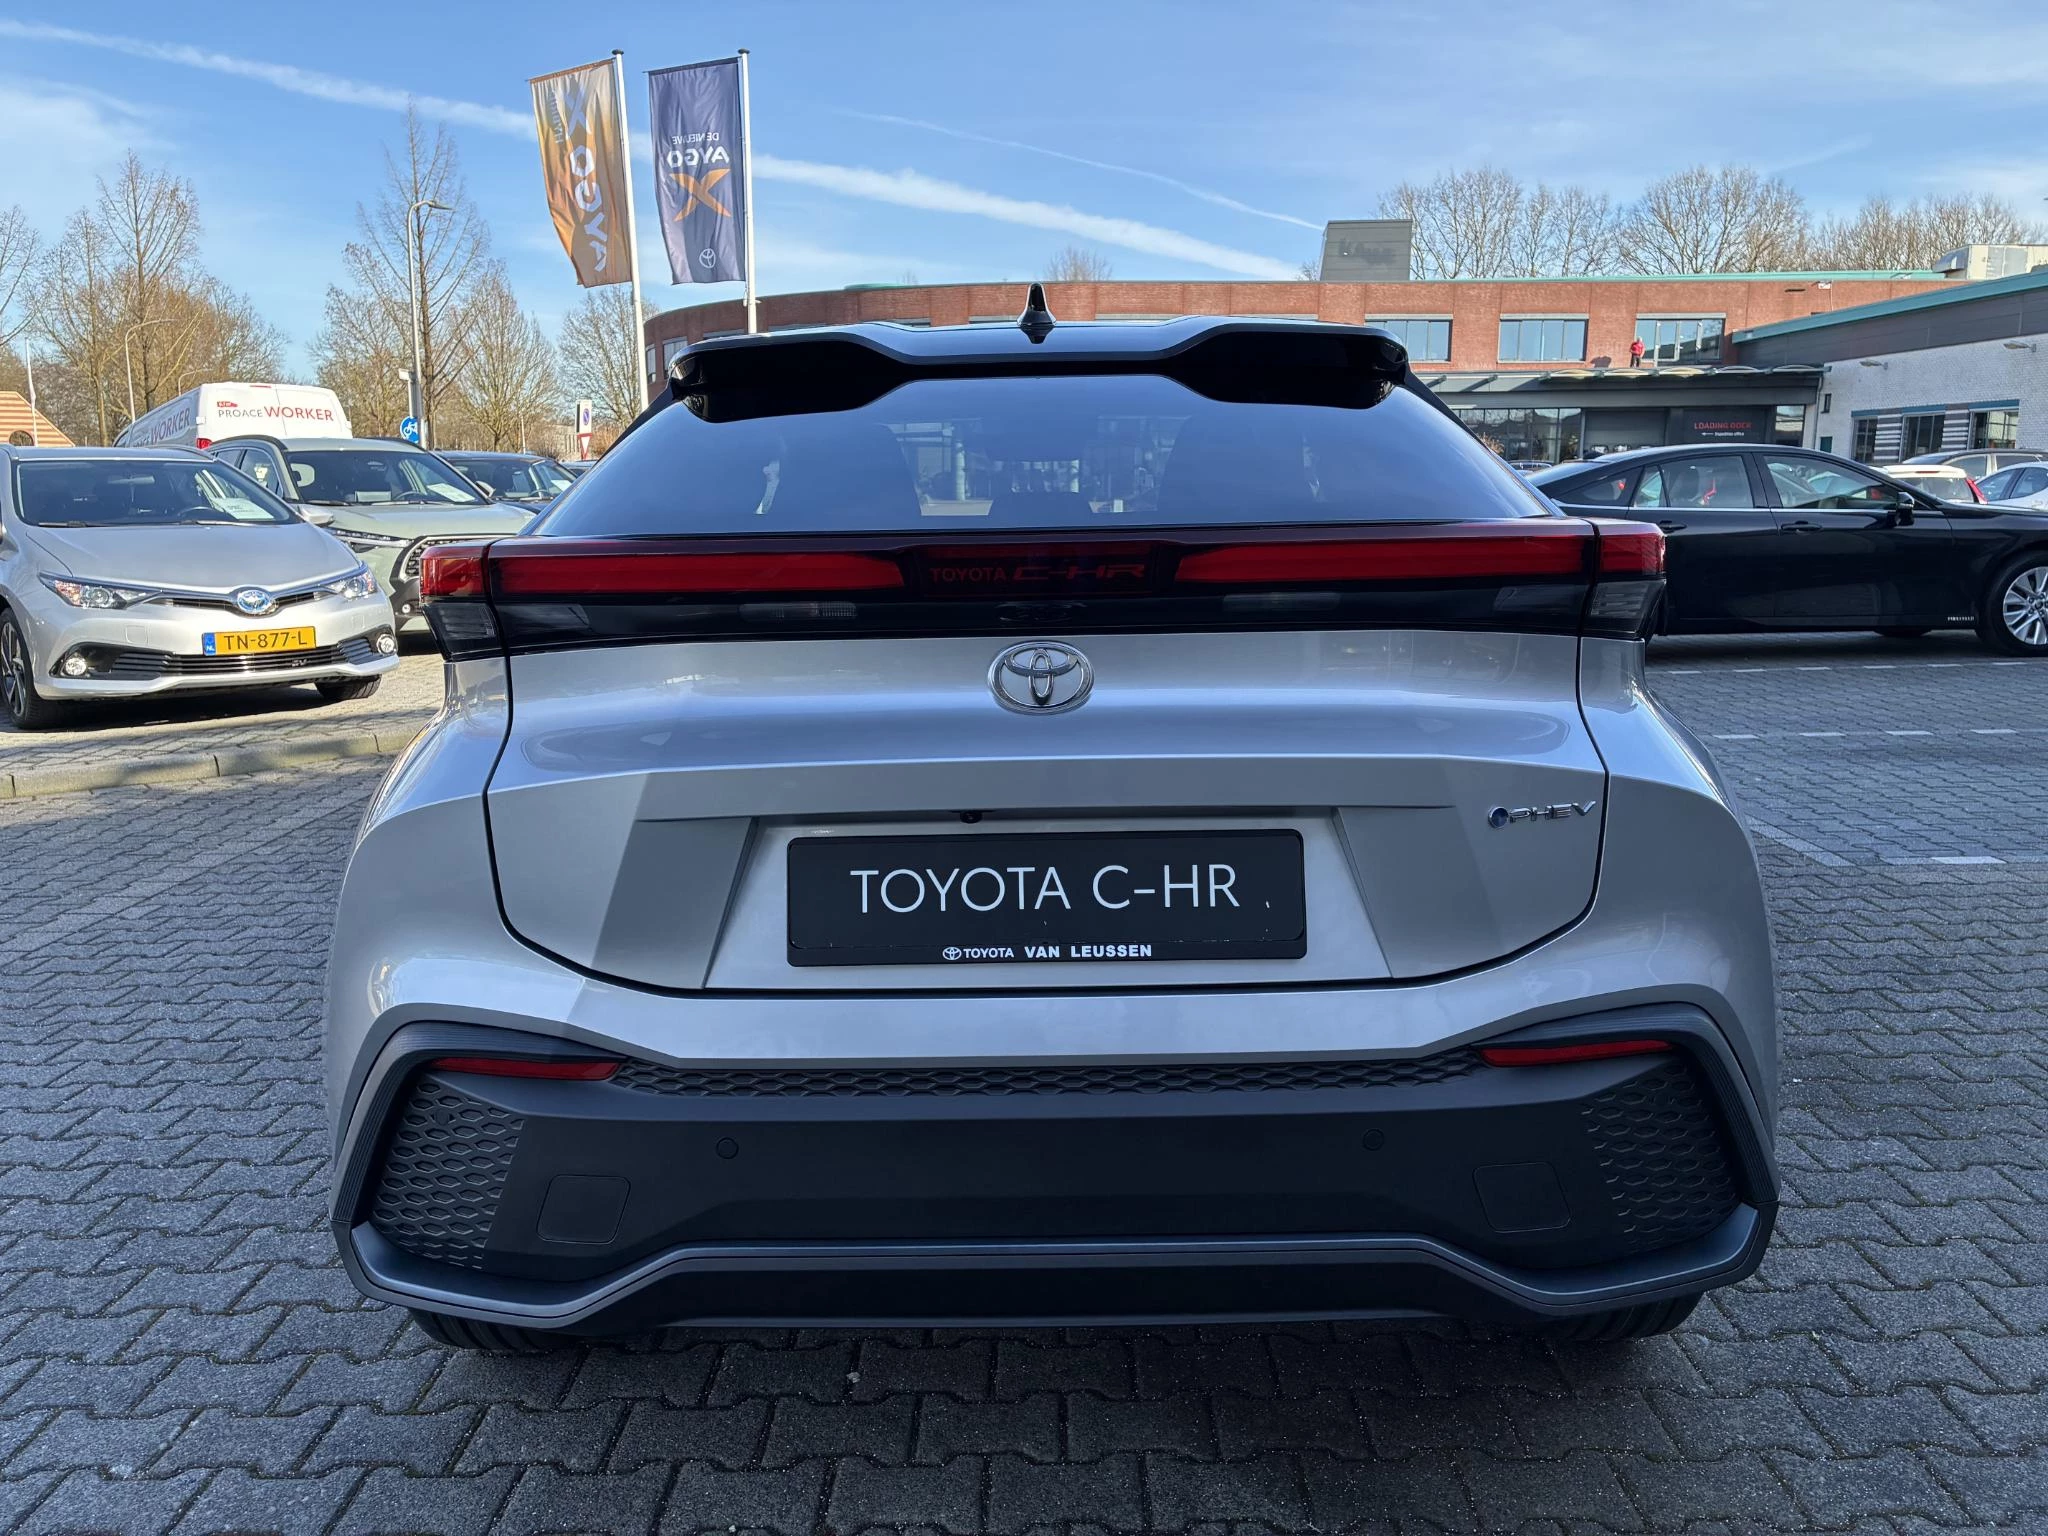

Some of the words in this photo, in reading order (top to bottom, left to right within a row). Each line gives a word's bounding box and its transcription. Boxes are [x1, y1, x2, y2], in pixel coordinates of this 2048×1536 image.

[218, 409, 263, 418] PROACE
[264, 406, 334, 421] WORKER
[151, 407, 190, 445] WORKER
[1694, 421, 1729, 430] LOADING
[929, 567, 1007, 583] TOYOTA
[1013, 564, 1145, 581] C-HR
[206, 644, 215, 652] NL
[224, 630, 307, 650] TN-877-L
[850, 866, 1071, 914] TOYOTA
[1092, 864, 1240, 910] C-HR
[963, 947, 1014, 959] TOYOTA
[1024, 946, 1060, 958] VAN
[1071, 944, 1152, 958] LEUSSEN
